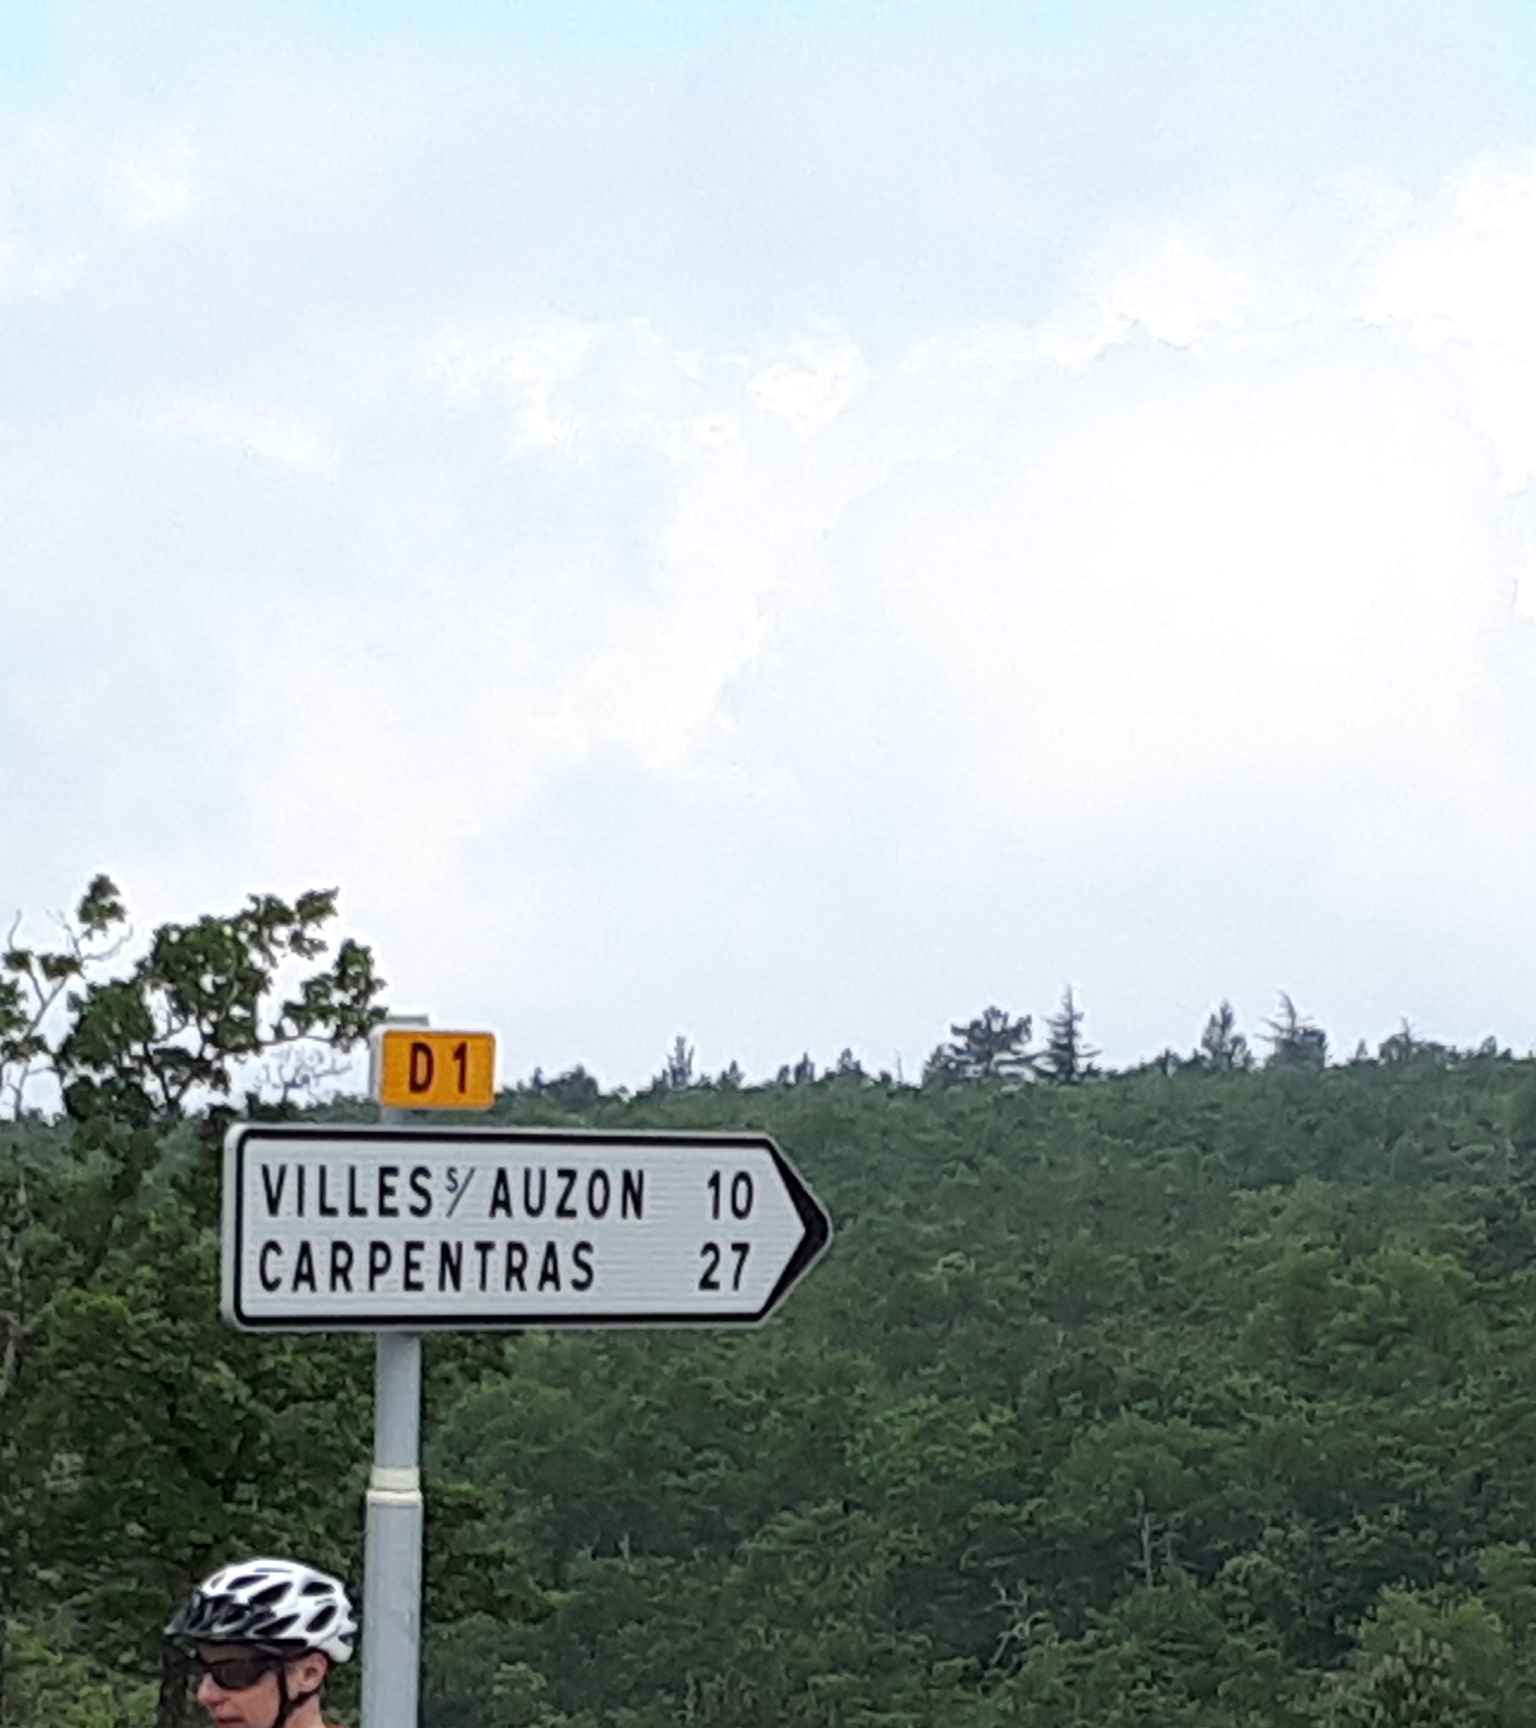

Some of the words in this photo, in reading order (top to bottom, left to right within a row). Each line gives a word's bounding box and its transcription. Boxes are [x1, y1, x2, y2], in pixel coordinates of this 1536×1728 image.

[408, 1041, 434, 1094] D
[452, 1041, 468, 1094] 1
[261, 1163, 433, 1218] VILLES
[488, 1166, 644, 1220] AUZON
[707, 1169, 754, 1221] 10
[259, 1239, 594, 1293] CARPENTRAS
[698, 1241, 751, 1291] 27
